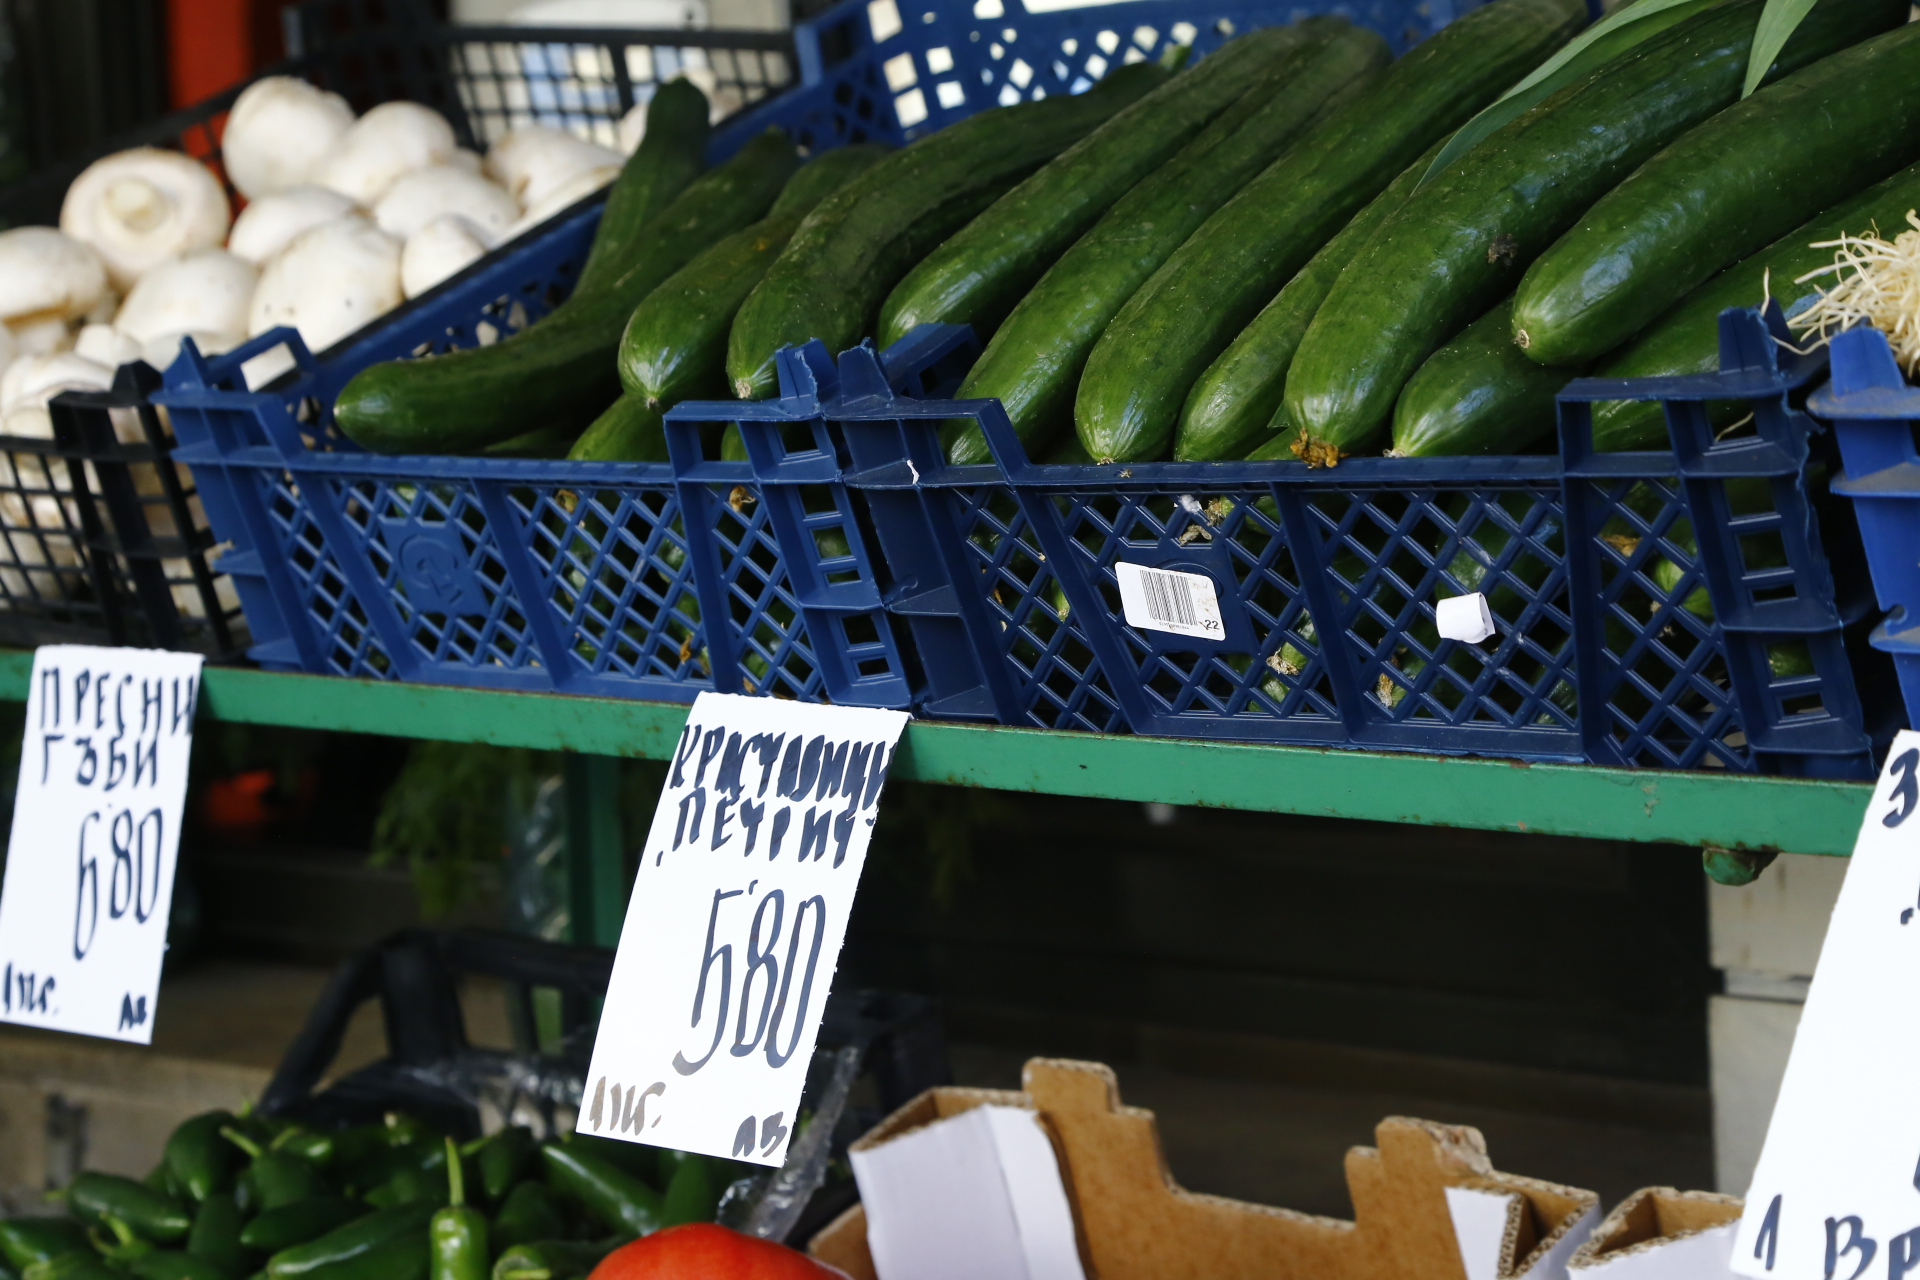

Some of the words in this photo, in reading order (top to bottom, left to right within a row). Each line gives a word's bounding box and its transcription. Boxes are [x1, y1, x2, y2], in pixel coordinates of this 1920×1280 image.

[1204, 619, 1220, 631] 22
[40, 667, 195, 736] ПРЕСНИ
[41, 734, 159, 791] ГЪБИ
